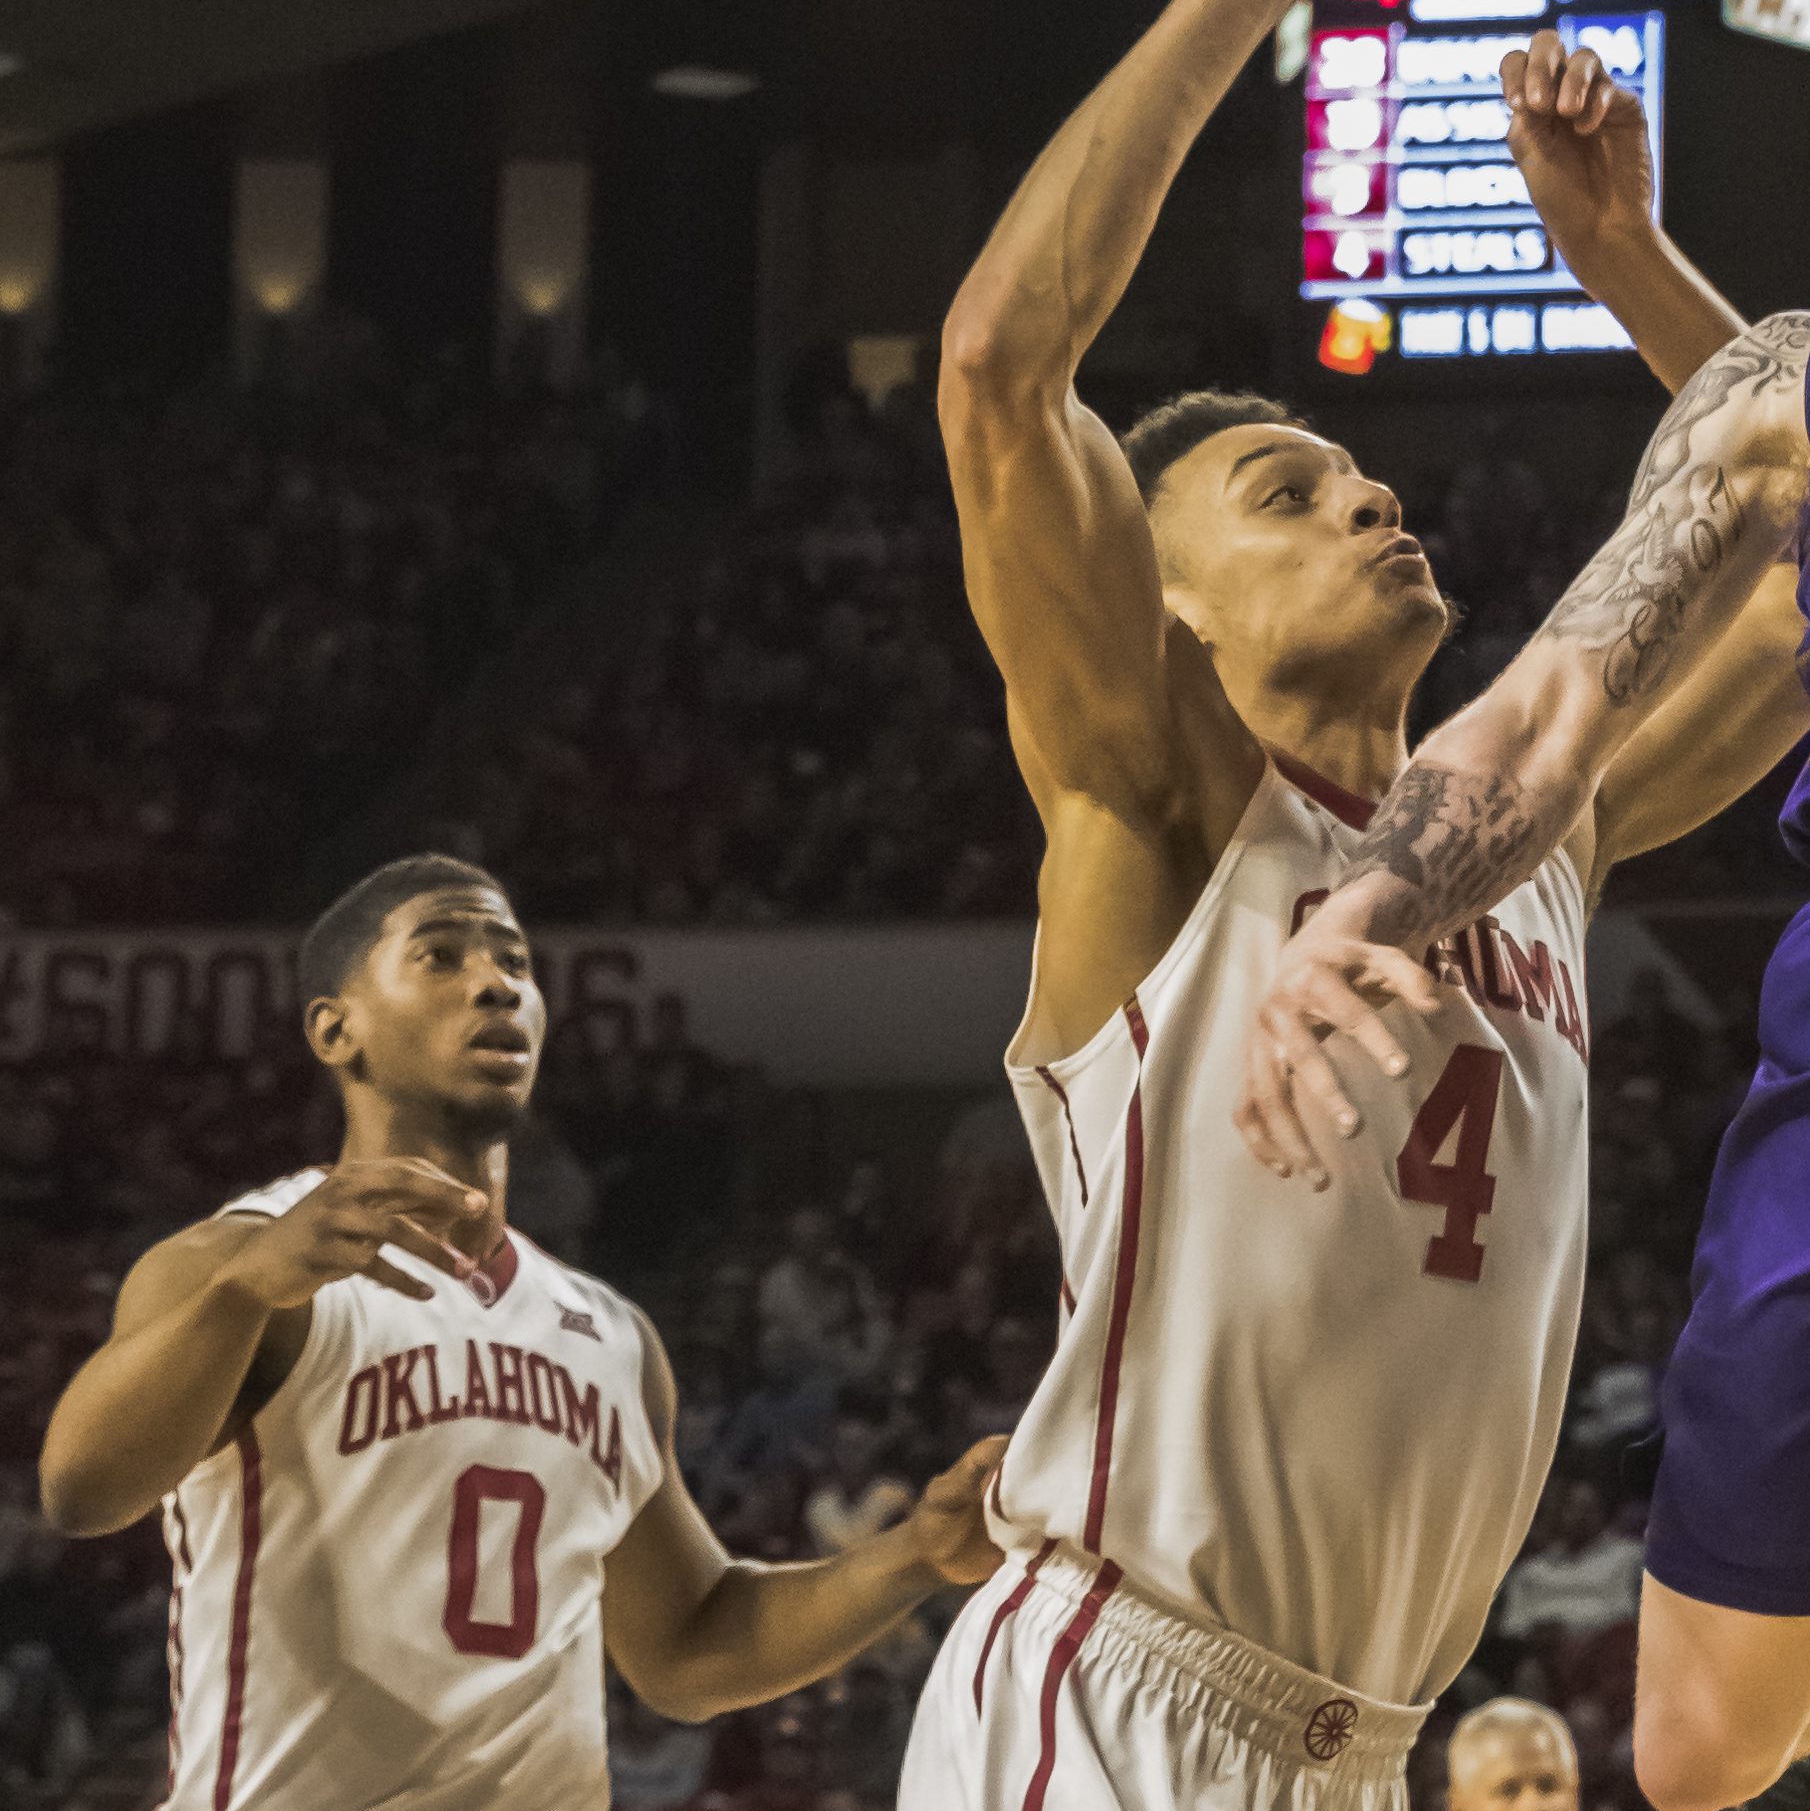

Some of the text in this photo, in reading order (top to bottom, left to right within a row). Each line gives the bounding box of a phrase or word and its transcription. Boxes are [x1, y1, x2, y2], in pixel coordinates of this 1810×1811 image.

[1395, 1042, 1505, 1282] 4
[336, 1338, 624, 1498] OKLAHOMA
[442, 1462, 546, 1660] 0
